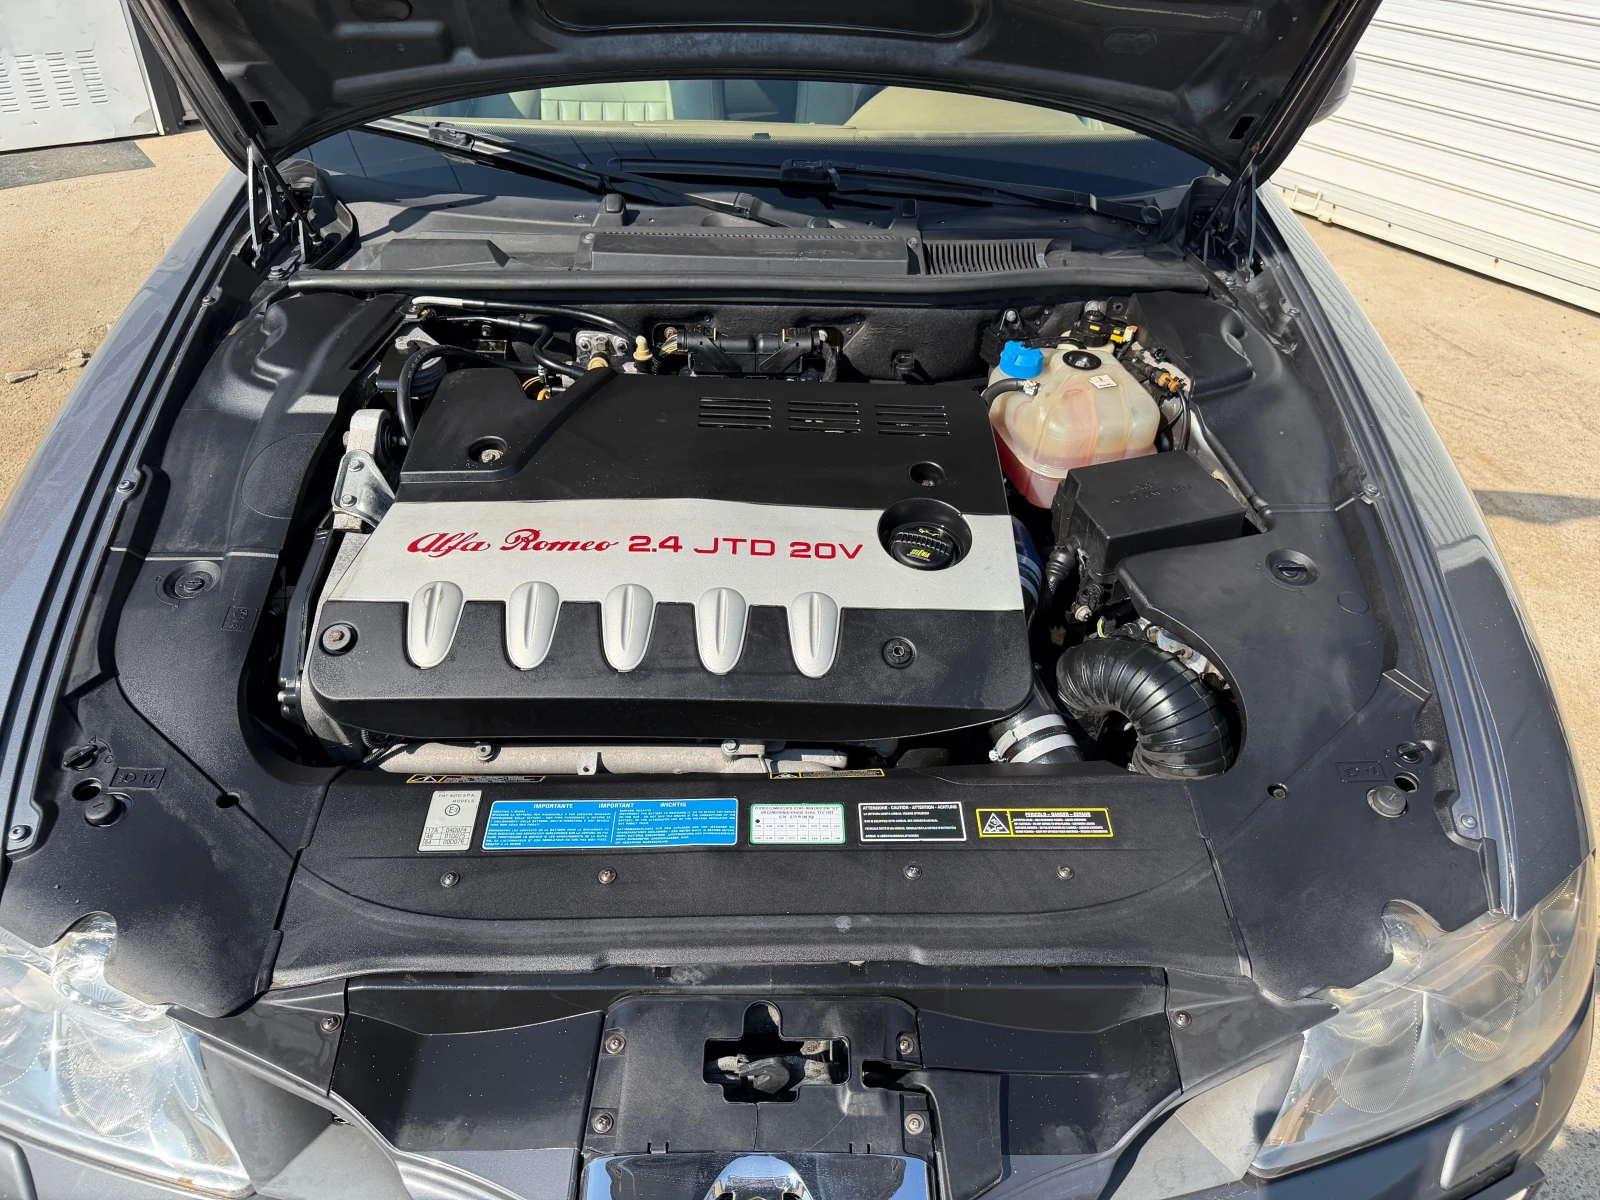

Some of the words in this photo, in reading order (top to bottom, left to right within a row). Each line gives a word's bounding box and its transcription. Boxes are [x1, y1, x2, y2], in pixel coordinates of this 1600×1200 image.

[406, 531, 491, 558] Alfa
[499, 528, 618, 553] Romeo
[628, 535, 683, 553] 2.4
[693, 537, 776, 556] JTD
[789, 542, 864, 560] 20V
